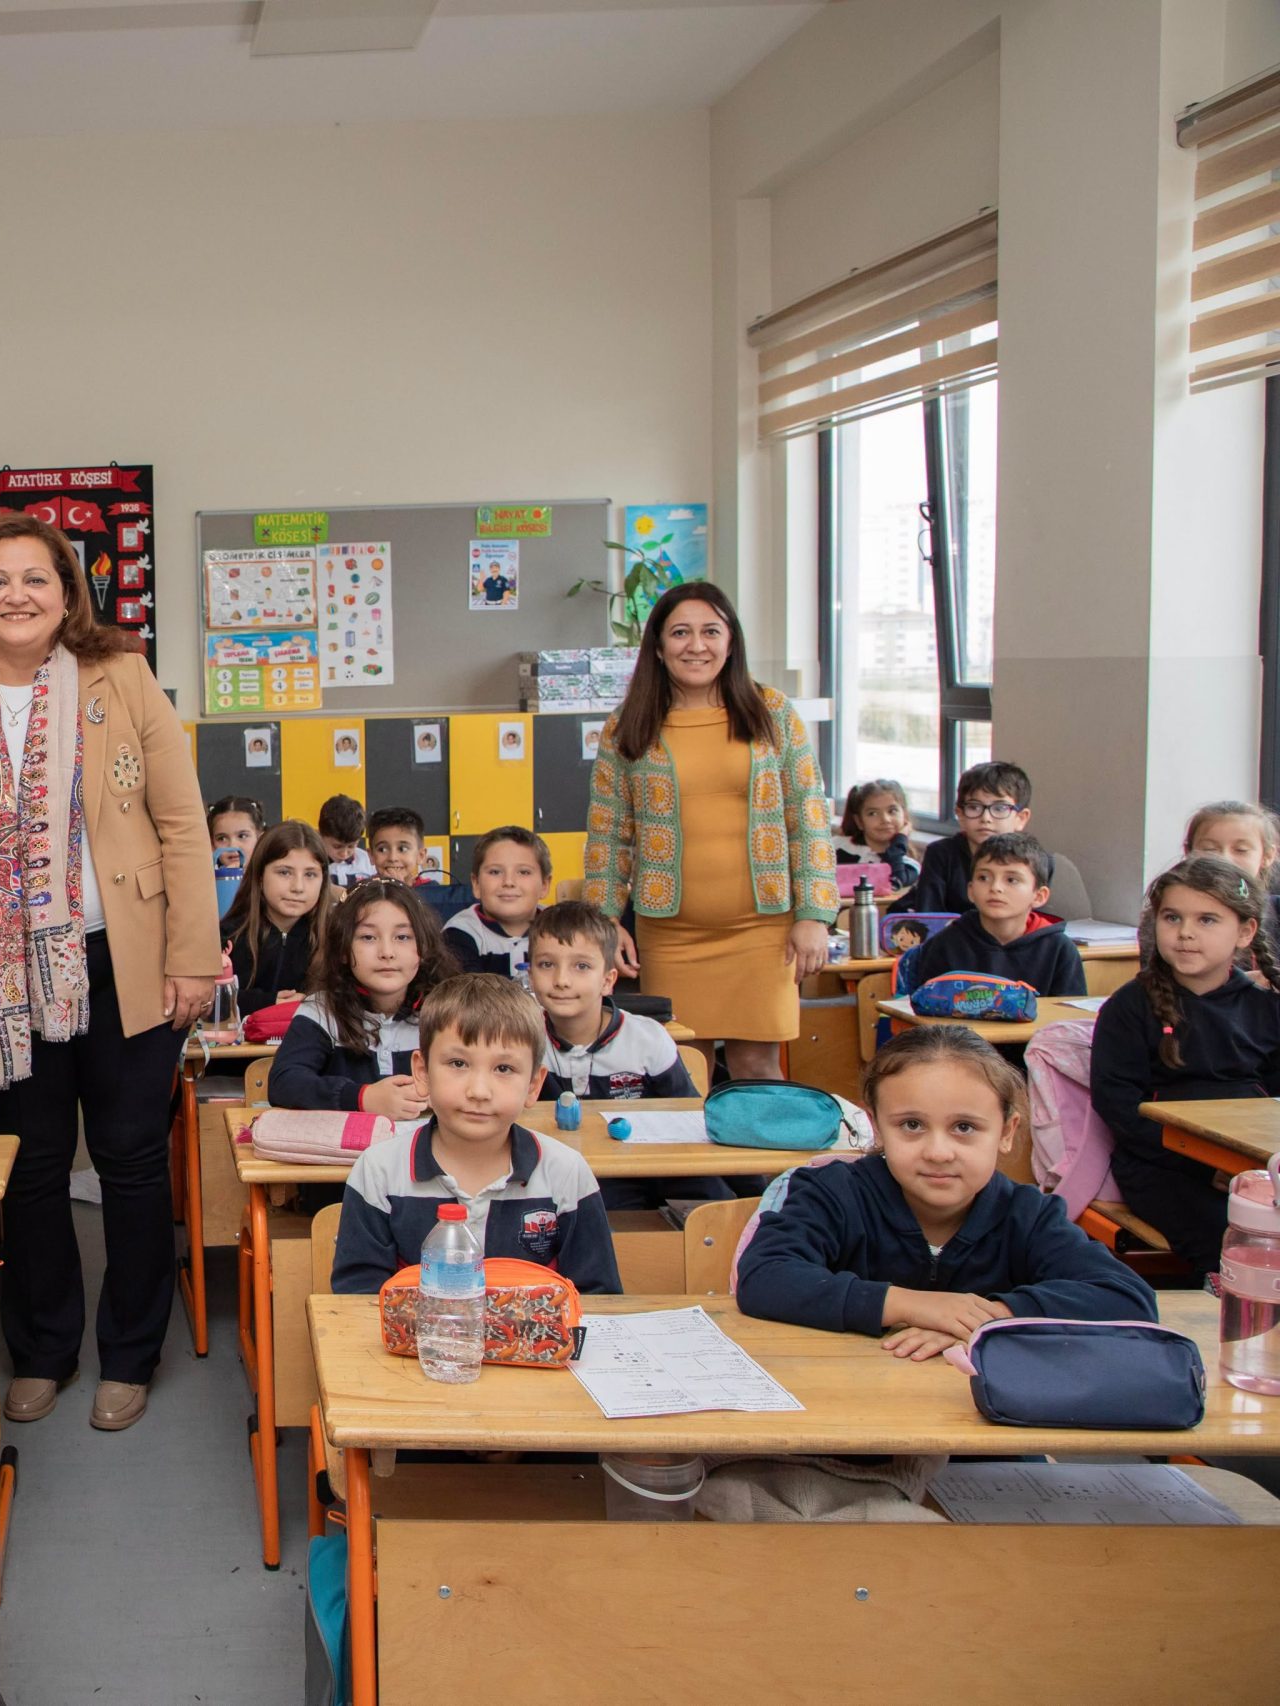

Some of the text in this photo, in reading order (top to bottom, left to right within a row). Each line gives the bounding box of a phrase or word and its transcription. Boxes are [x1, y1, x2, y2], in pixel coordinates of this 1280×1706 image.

[8, 471, 113, 488] ATATÜRK KÖŞESİ
[120, 503, 140, 514] 1938
[258, 514, 325, 526] MATEMATİK
[271, 528, 312, 543] KÖŞESİ
